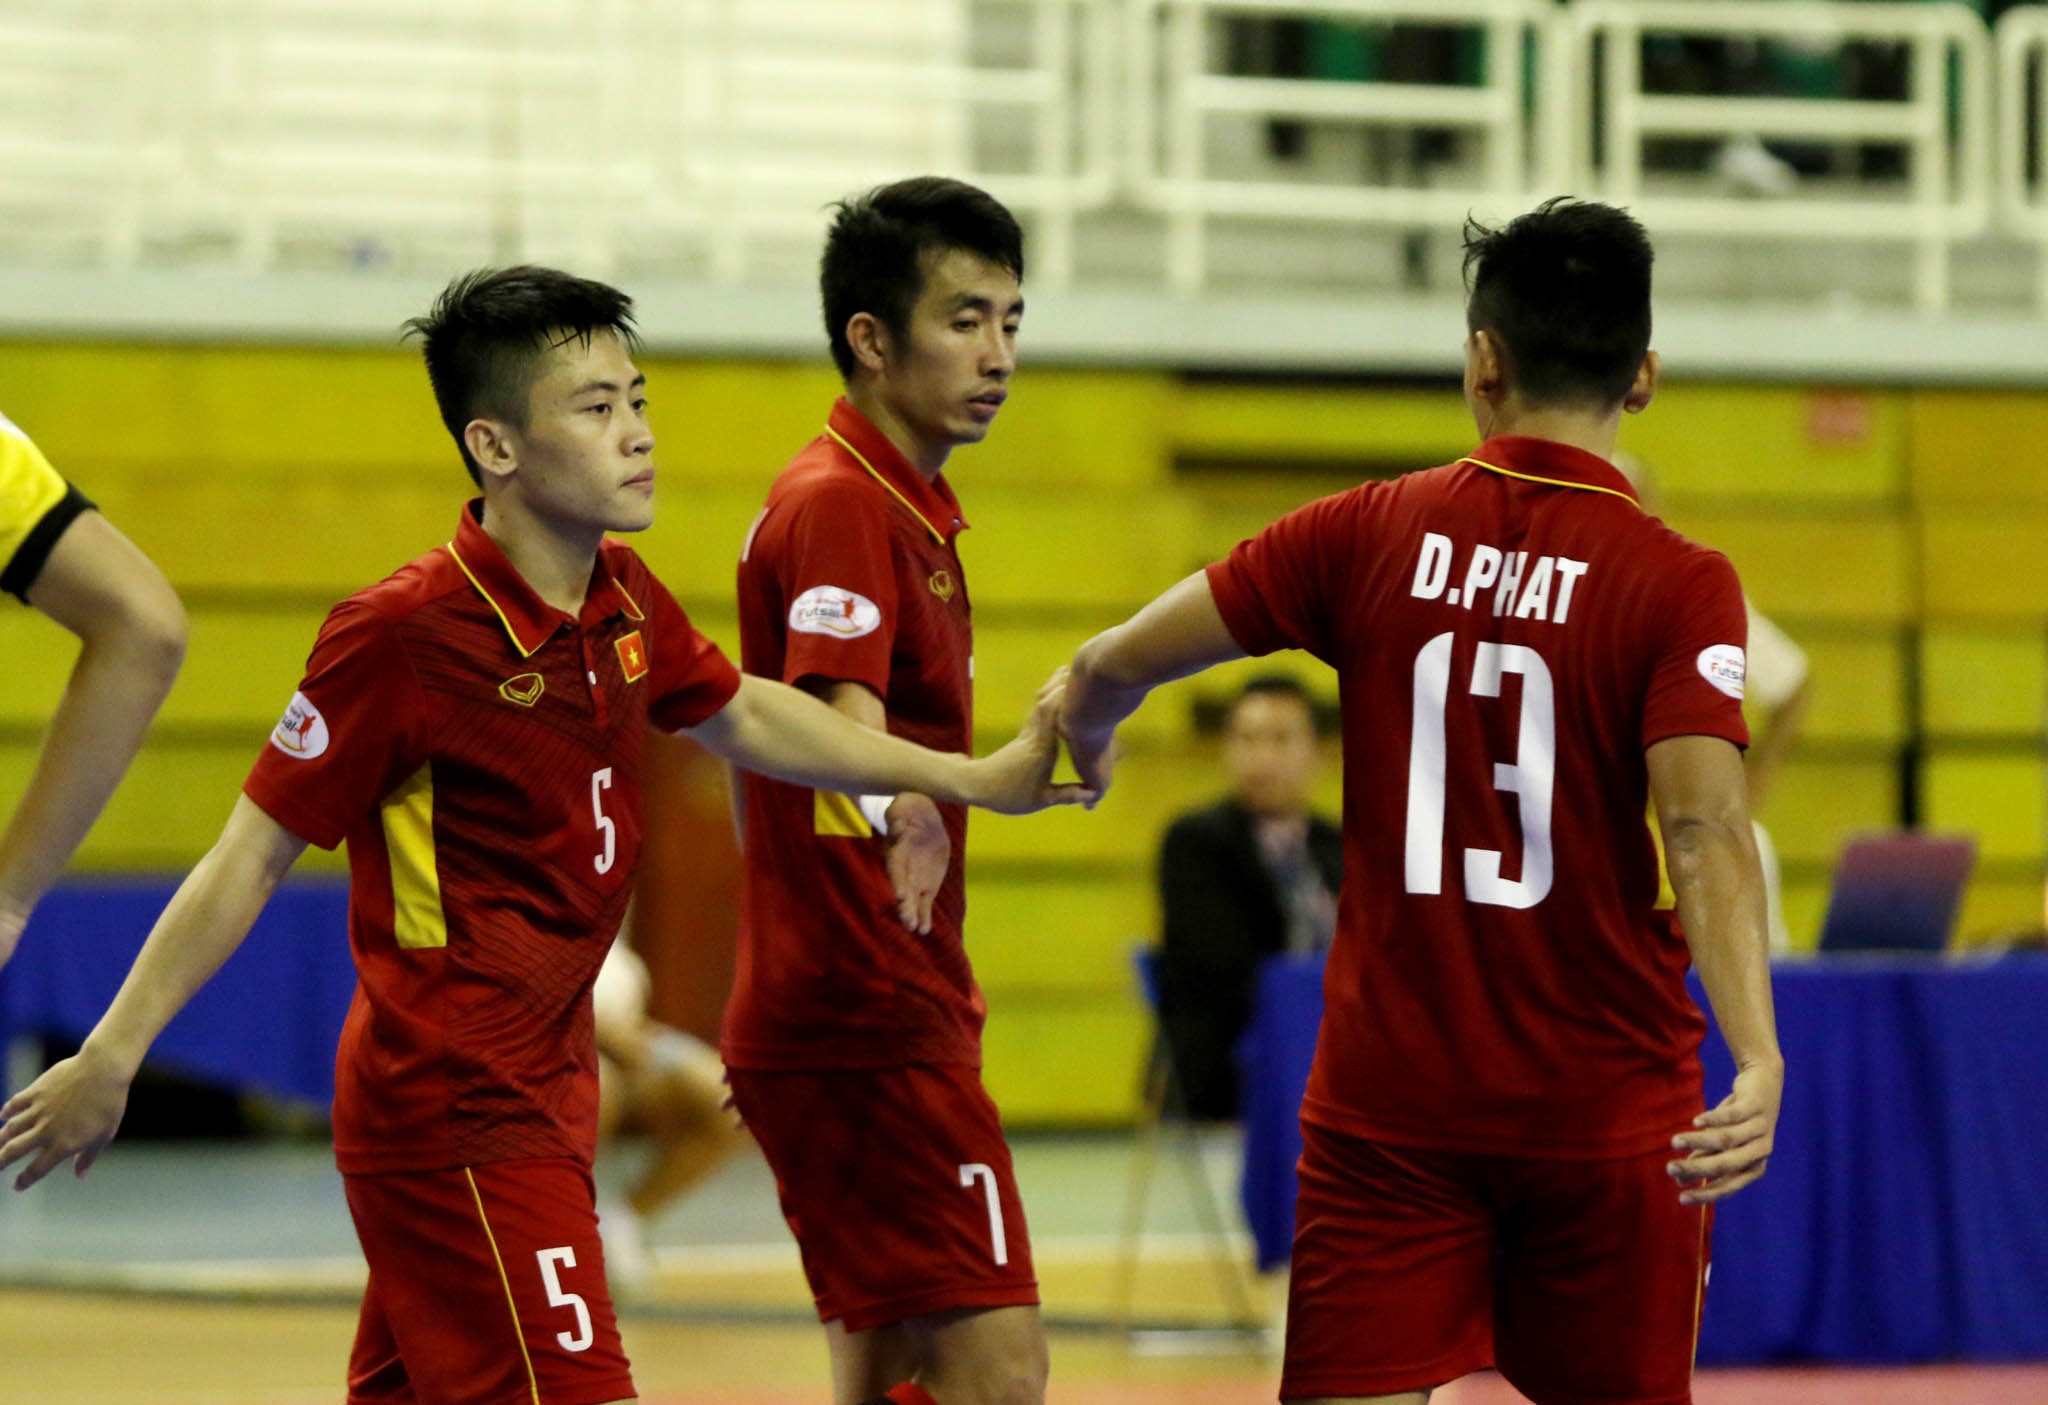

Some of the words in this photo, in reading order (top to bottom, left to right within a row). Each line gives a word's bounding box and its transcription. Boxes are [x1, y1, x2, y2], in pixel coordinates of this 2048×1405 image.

[1411, 532, 1589, 624] D.PHAT
[592, 767, 615, 875] 5
[1405, 632, 1556, 909] 13
[959, 1163, 1008, 1265] 7
[536, 1246, 594, 1352] 5
